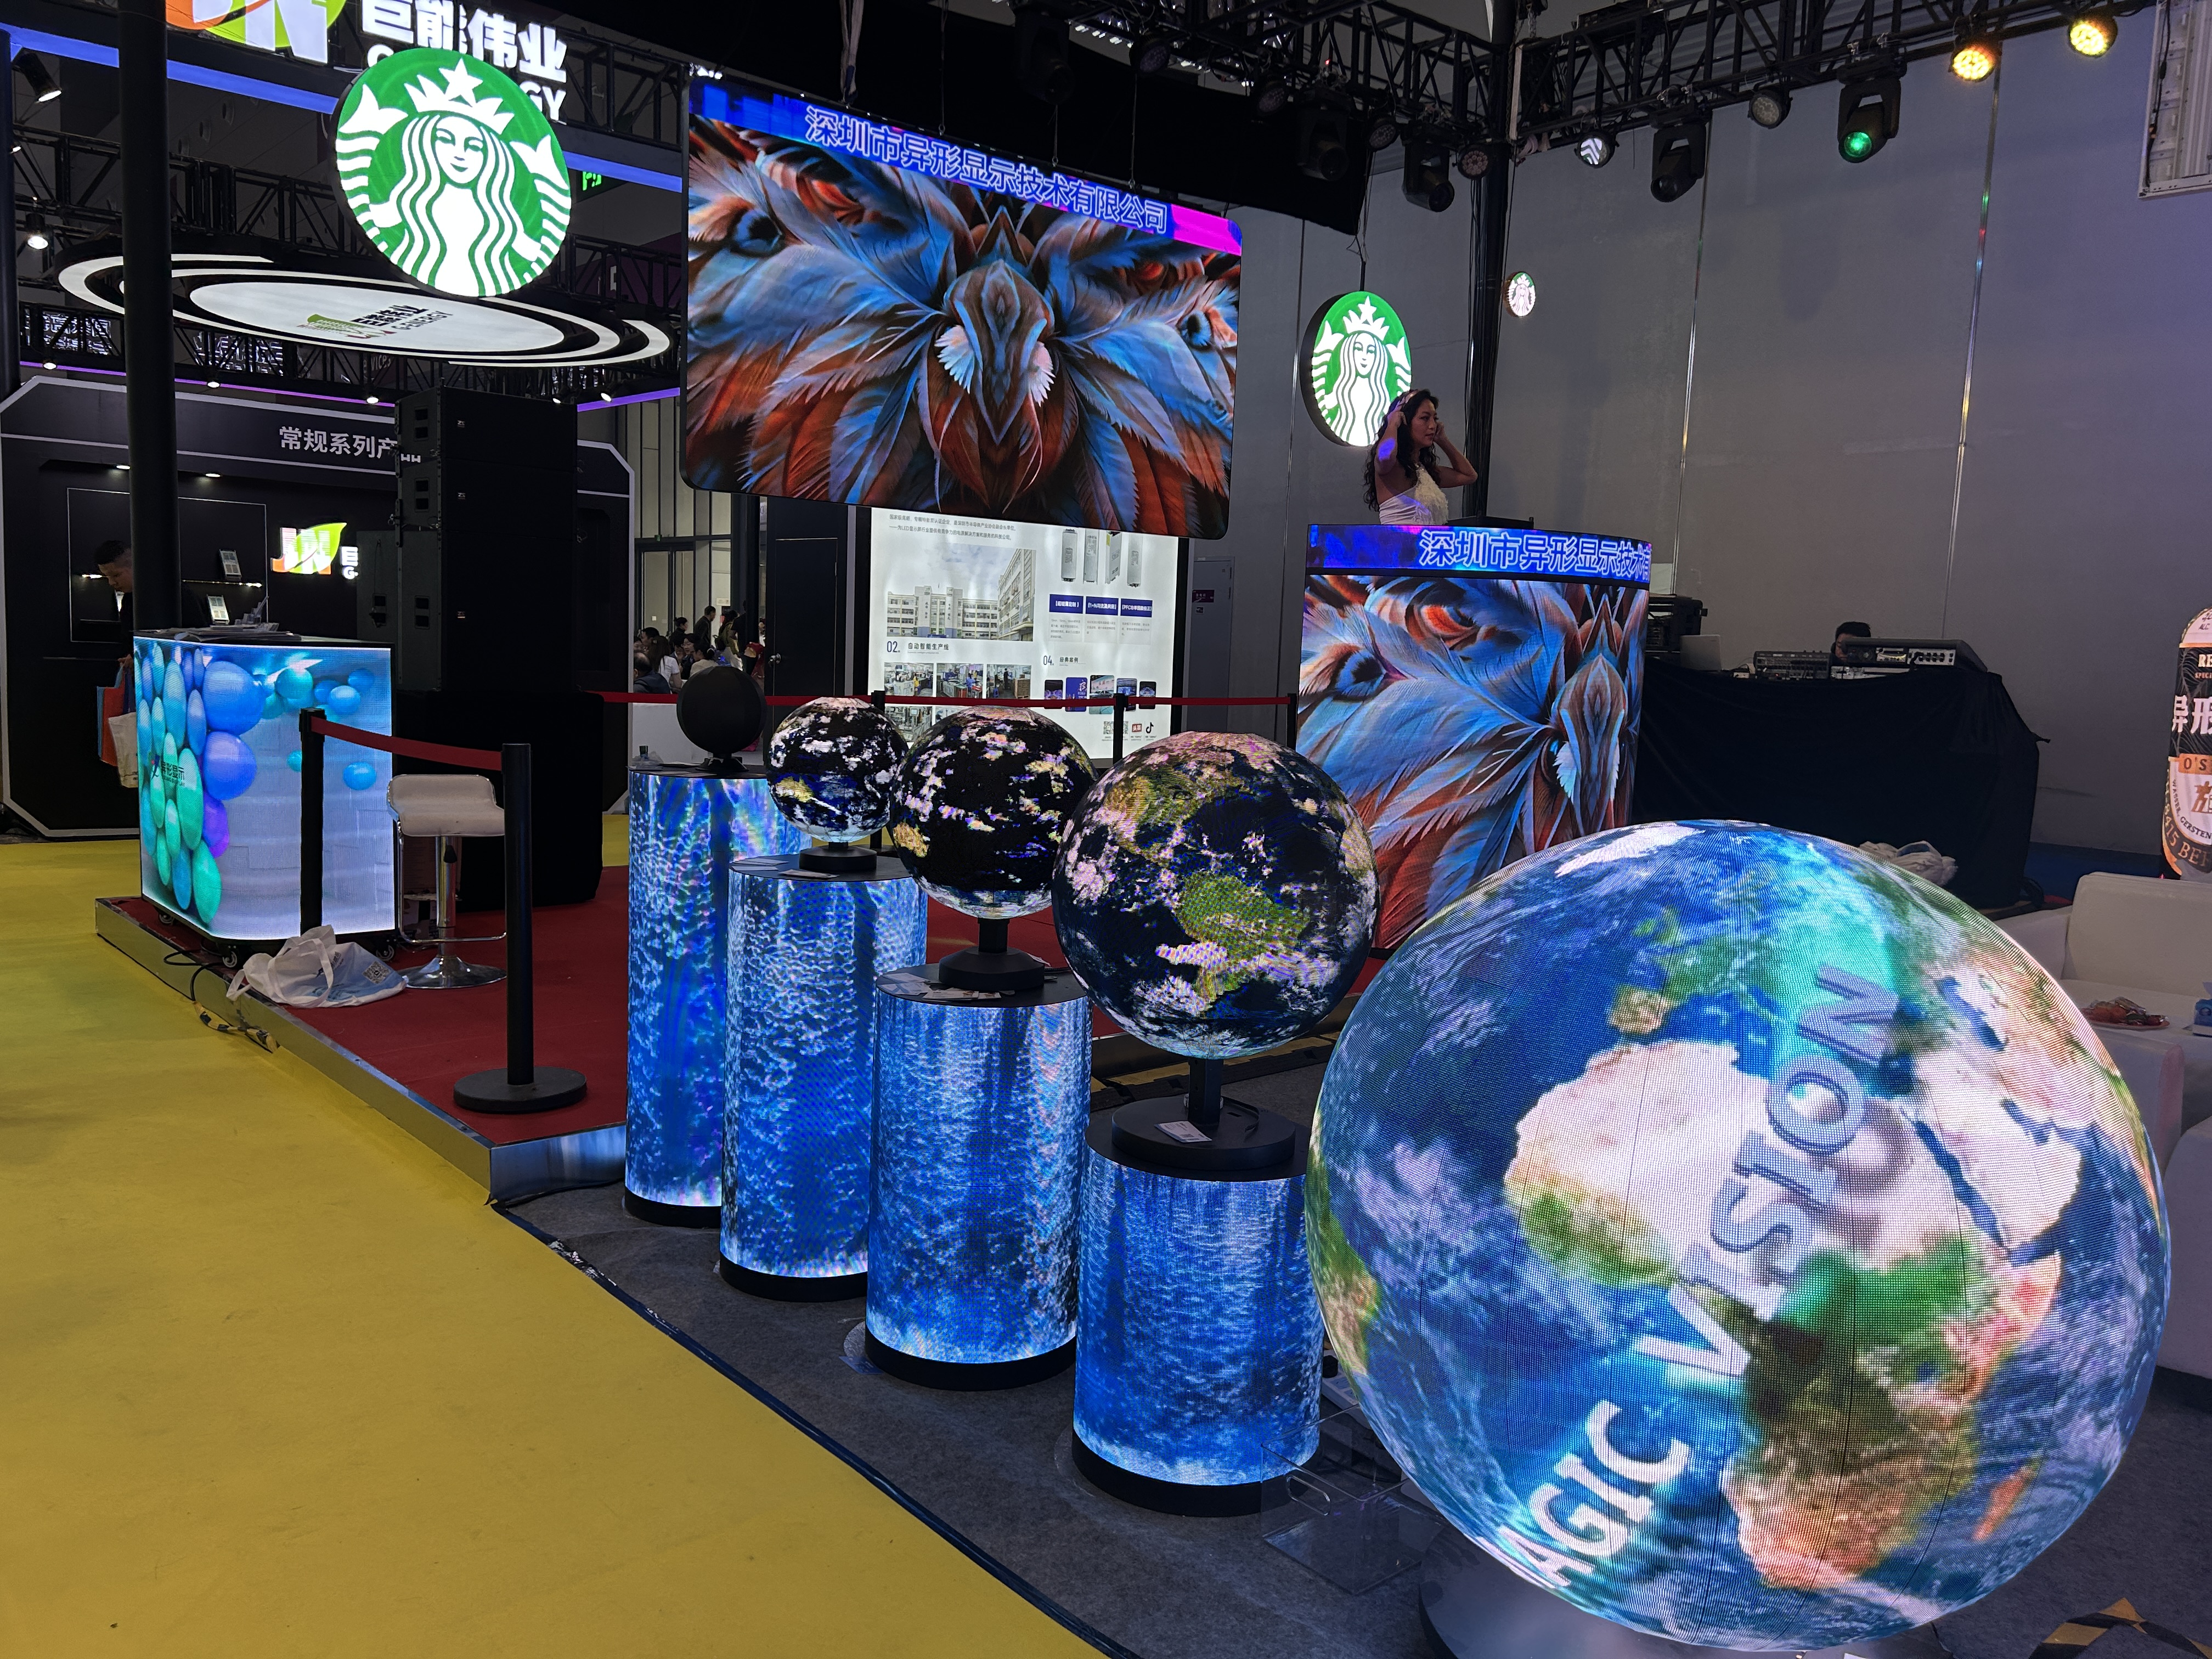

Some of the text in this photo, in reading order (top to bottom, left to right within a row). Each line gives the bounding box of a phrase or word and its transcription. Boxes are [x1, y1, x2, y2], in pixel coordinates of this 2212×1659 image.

[805, 104, 1167, 234] 深圳市异形显示技术有限公司
[908, 642, 949, 651] 自动智能生产线
[1636, 964, 1901, 1378] VISION
